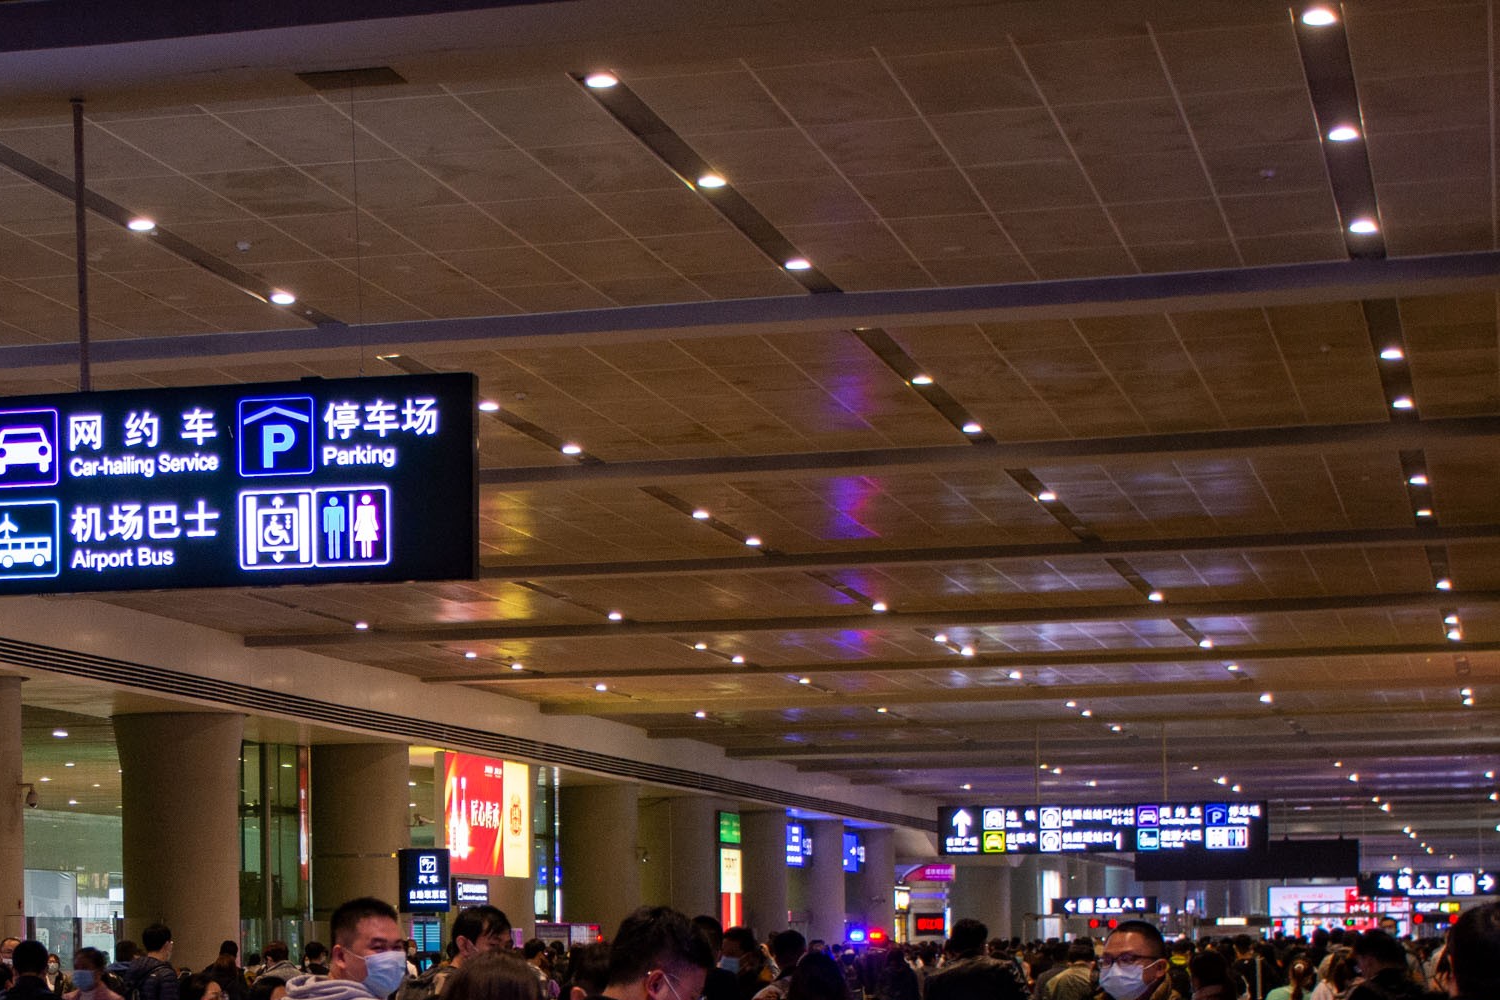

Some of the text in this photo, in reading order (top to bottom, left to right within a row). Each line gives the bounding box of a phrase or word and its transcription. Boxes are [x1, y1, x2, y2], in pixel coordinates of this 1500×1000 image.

[69, 408, 218, 452] 网约车
[323, 398, 438, 440] 停车场
[69, 452, 219, 478] Car-hailing Service
[322, 444, 396, 468] Parking
[70, 500, 220, 543] 机场巴士
[71, 546, 175, 572] Airport Bus
